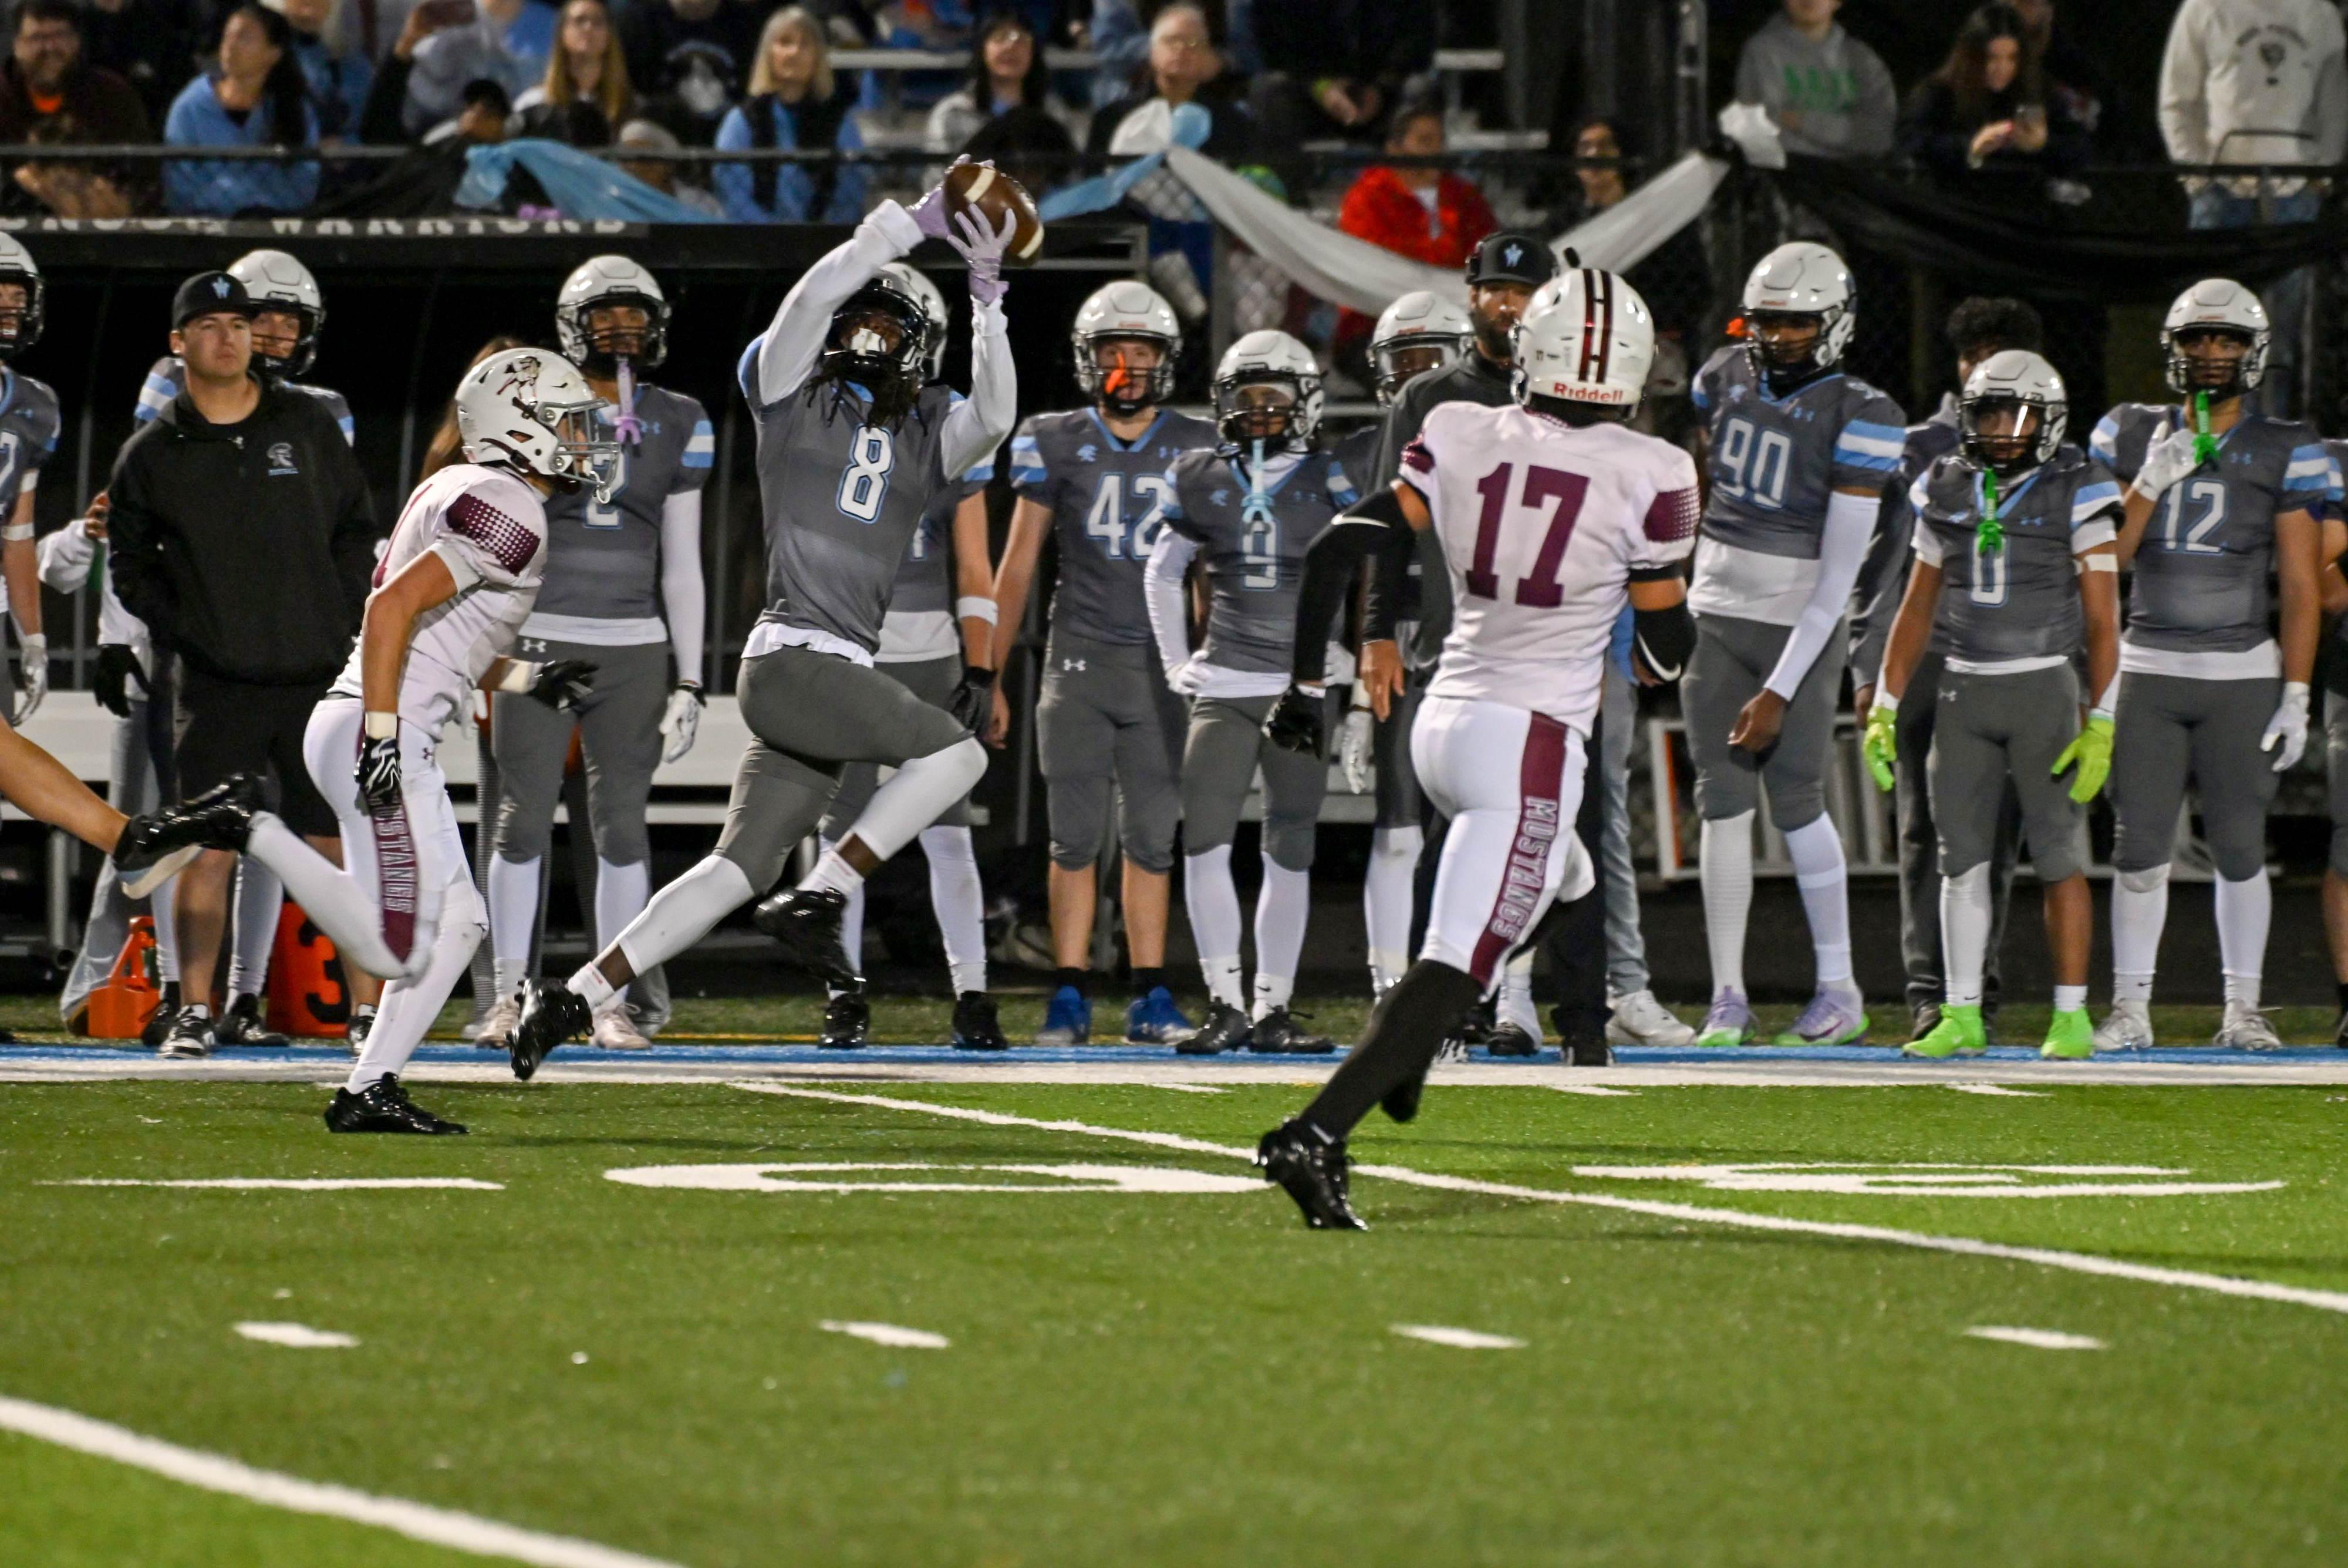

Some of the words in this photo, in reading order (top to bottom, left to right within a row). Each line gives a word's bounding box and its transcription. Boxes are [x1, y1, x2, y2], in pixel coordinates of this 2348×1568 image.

[1553, 382, 1624, 402] Riddell
[582, 450, 628, 528] 2
[836, 424, 895, 524] 8
[1719, 416, 1793, 510] 90
[1084, 472, 1175, 559] 42
[1466, 461, 1591, 609] 17
[2161, 478, 2229, 555] 12
[1489, 794, 1558, 943] MUSTANGS
[298, 918, 351, 1024] 3
